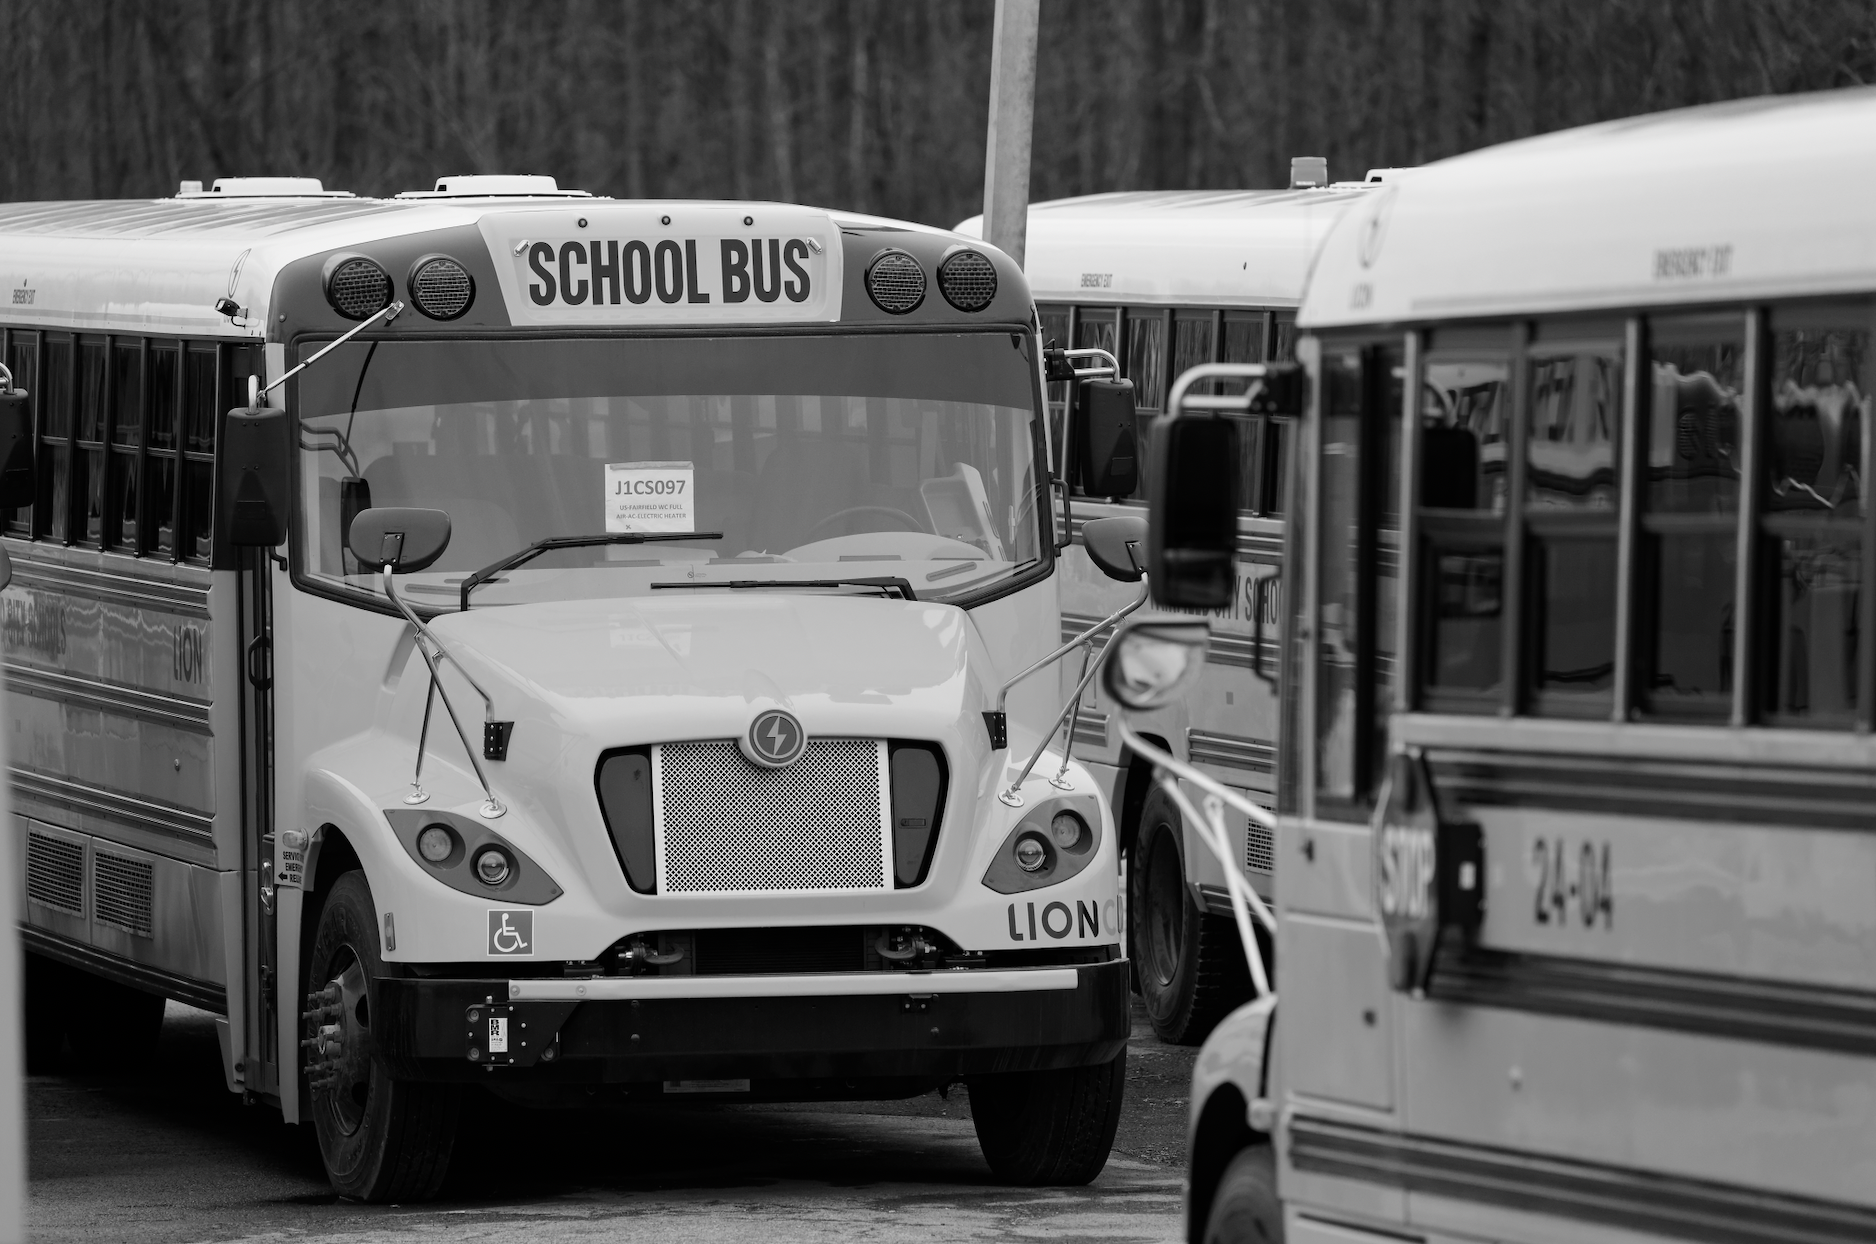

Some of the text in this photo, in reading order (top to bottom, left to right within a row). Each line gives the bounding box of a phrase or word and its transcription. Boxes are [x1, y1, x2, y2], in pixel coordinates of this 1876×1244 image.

[528, 238, 811, 306] SCHOOL BUS
[615, 480, 686, 495] J1CS097
[173, 625, 202, 684] LION
[1383, 824, 1435, 919] STOP
[1533, 836, 1613, 931] 24-04
